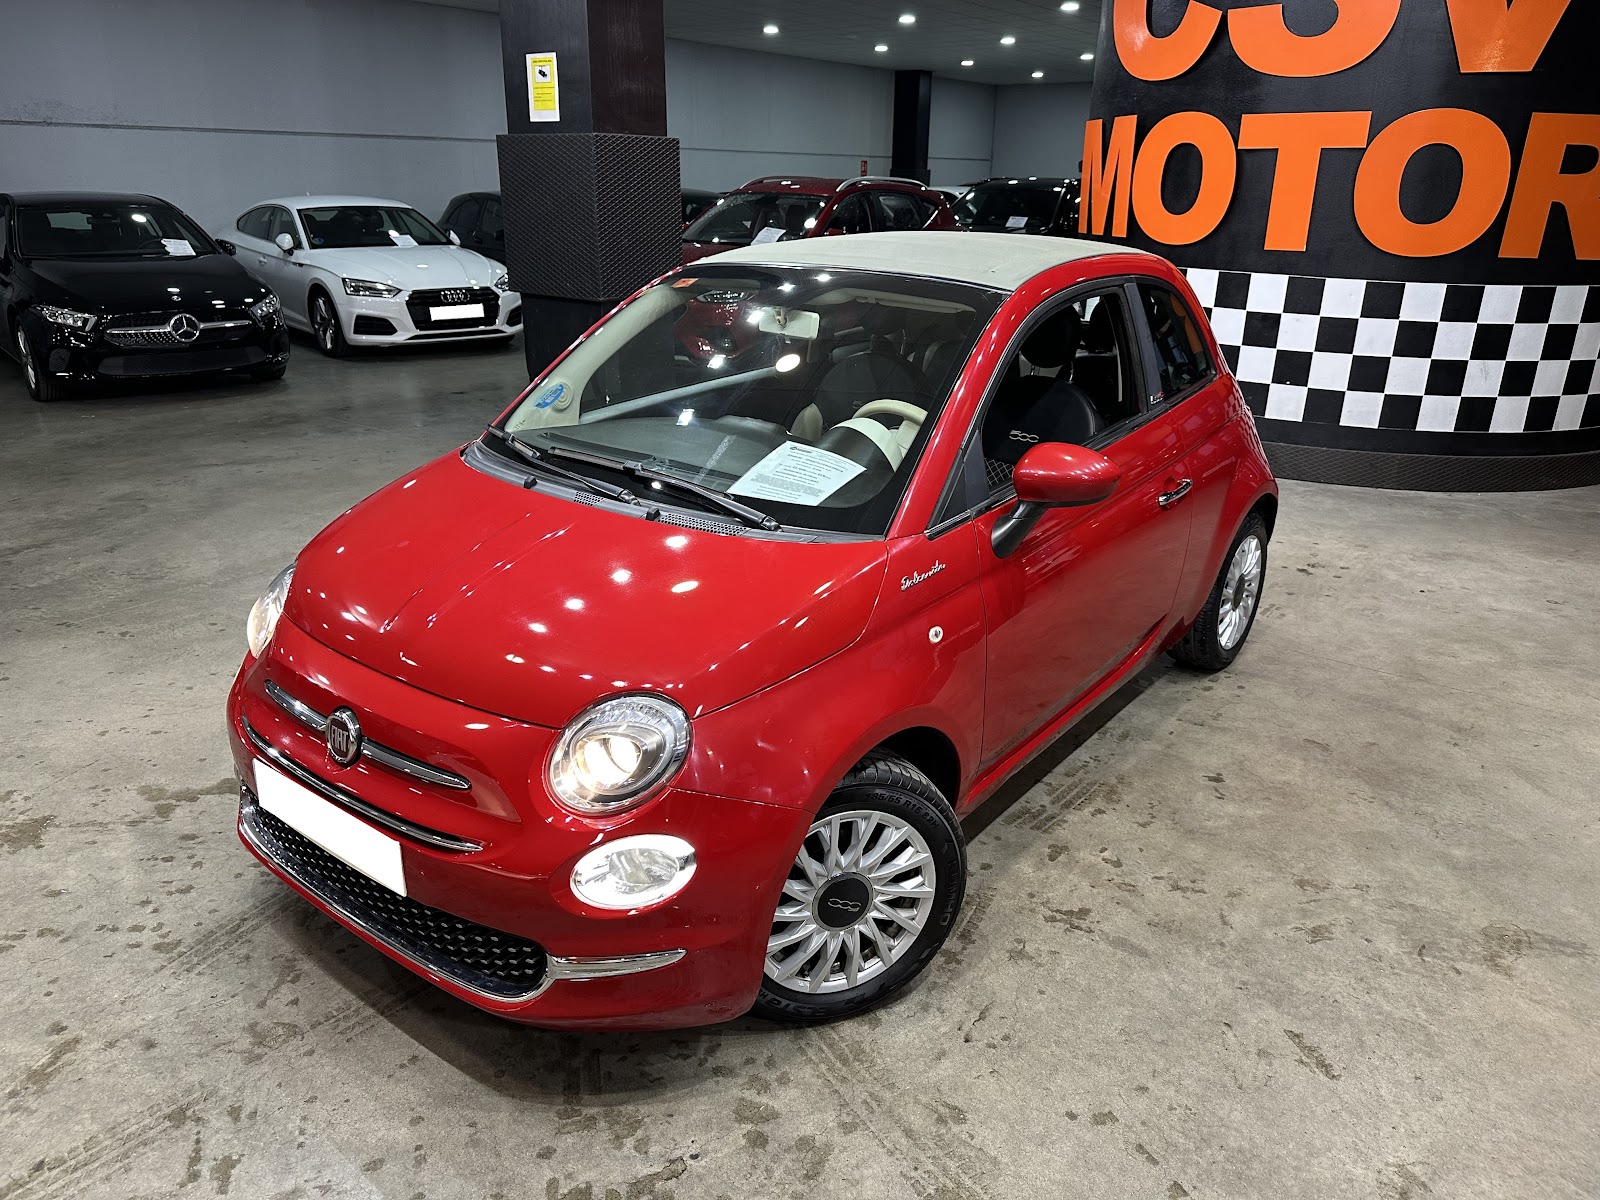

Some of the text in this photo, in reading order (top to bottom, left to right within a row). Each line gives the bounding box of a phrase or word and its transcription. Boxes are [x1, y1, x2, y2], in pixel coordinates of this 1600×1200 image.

[1009, 430, 1039, 442] 500
[331, 725, 348, 752] FIAT
[828, 899, 861, 911] 500
